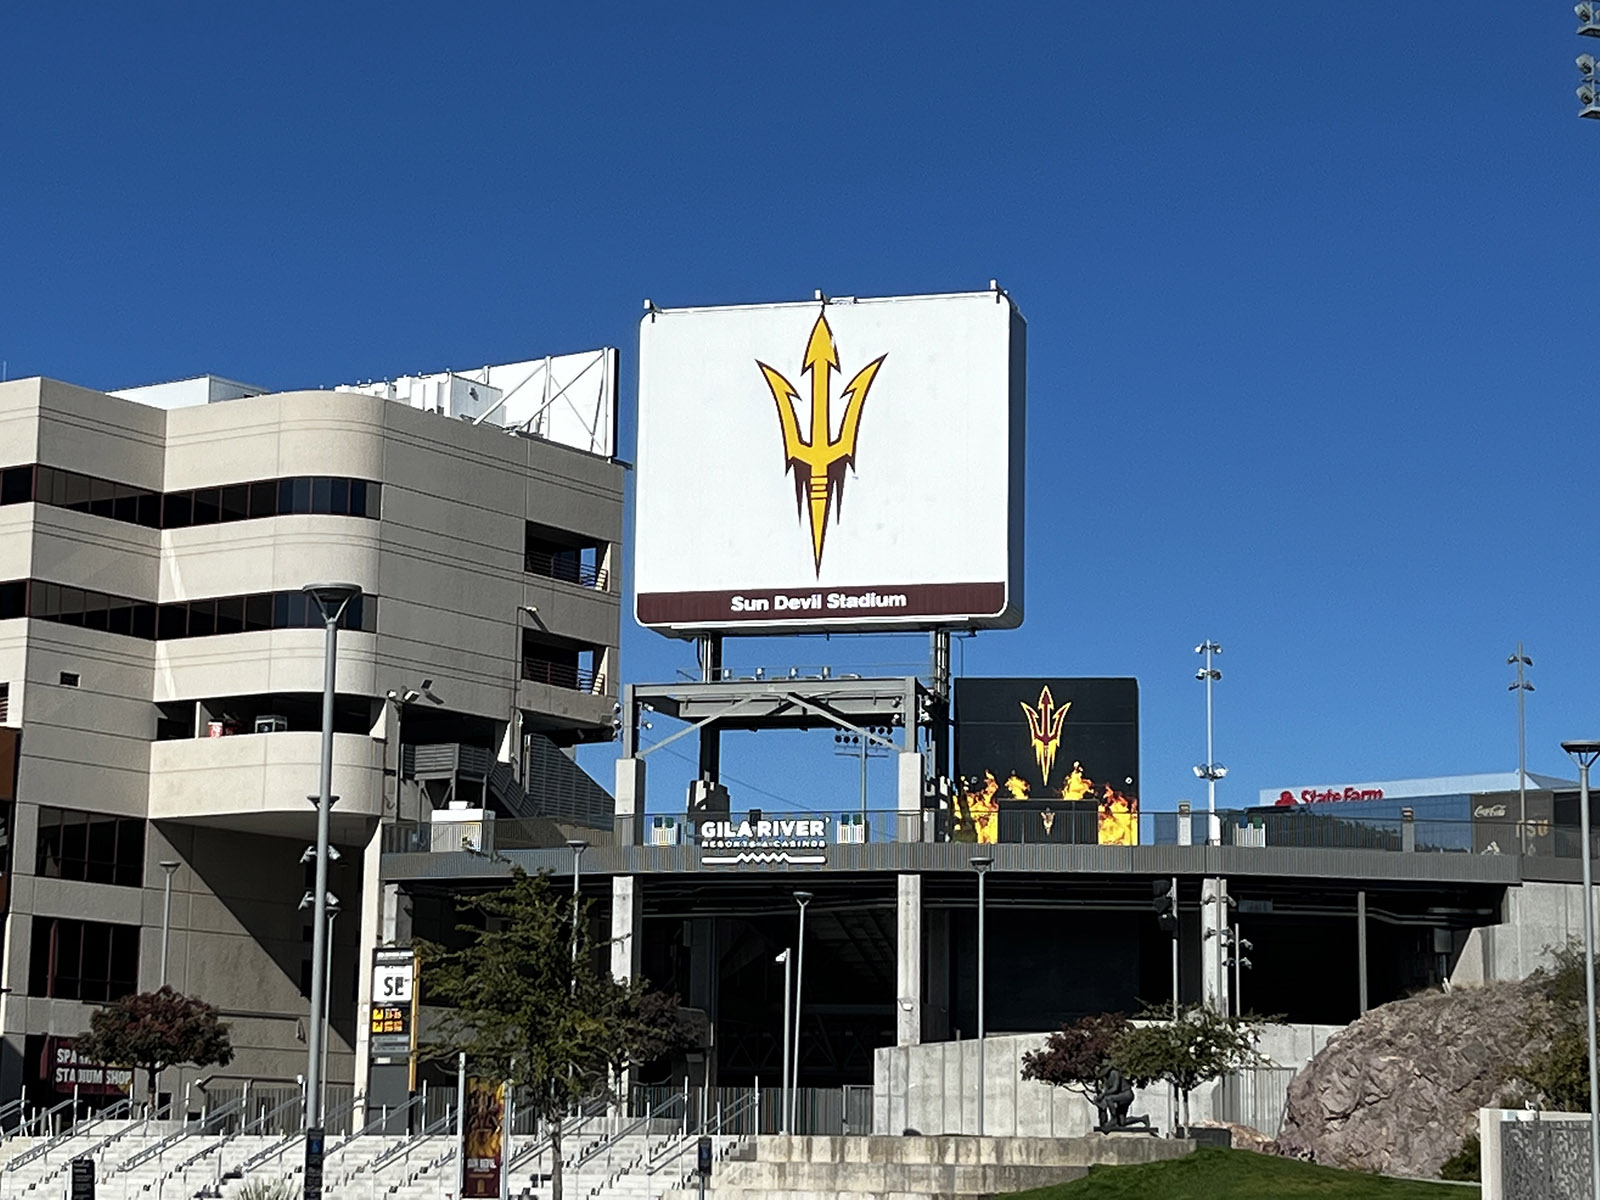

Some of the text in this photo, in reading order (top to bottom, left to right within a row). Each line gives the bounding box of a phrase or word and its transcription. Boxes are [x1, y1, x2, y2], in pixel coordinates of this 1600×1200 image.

[730, 592, 907, 612] Sun Devil Stadium
[1301, 787, 1384, 804] State Farm
[701, 820, 825, 838] GILA RIVER
[56, 1067, 133, 1085] STADIUM SHOP
